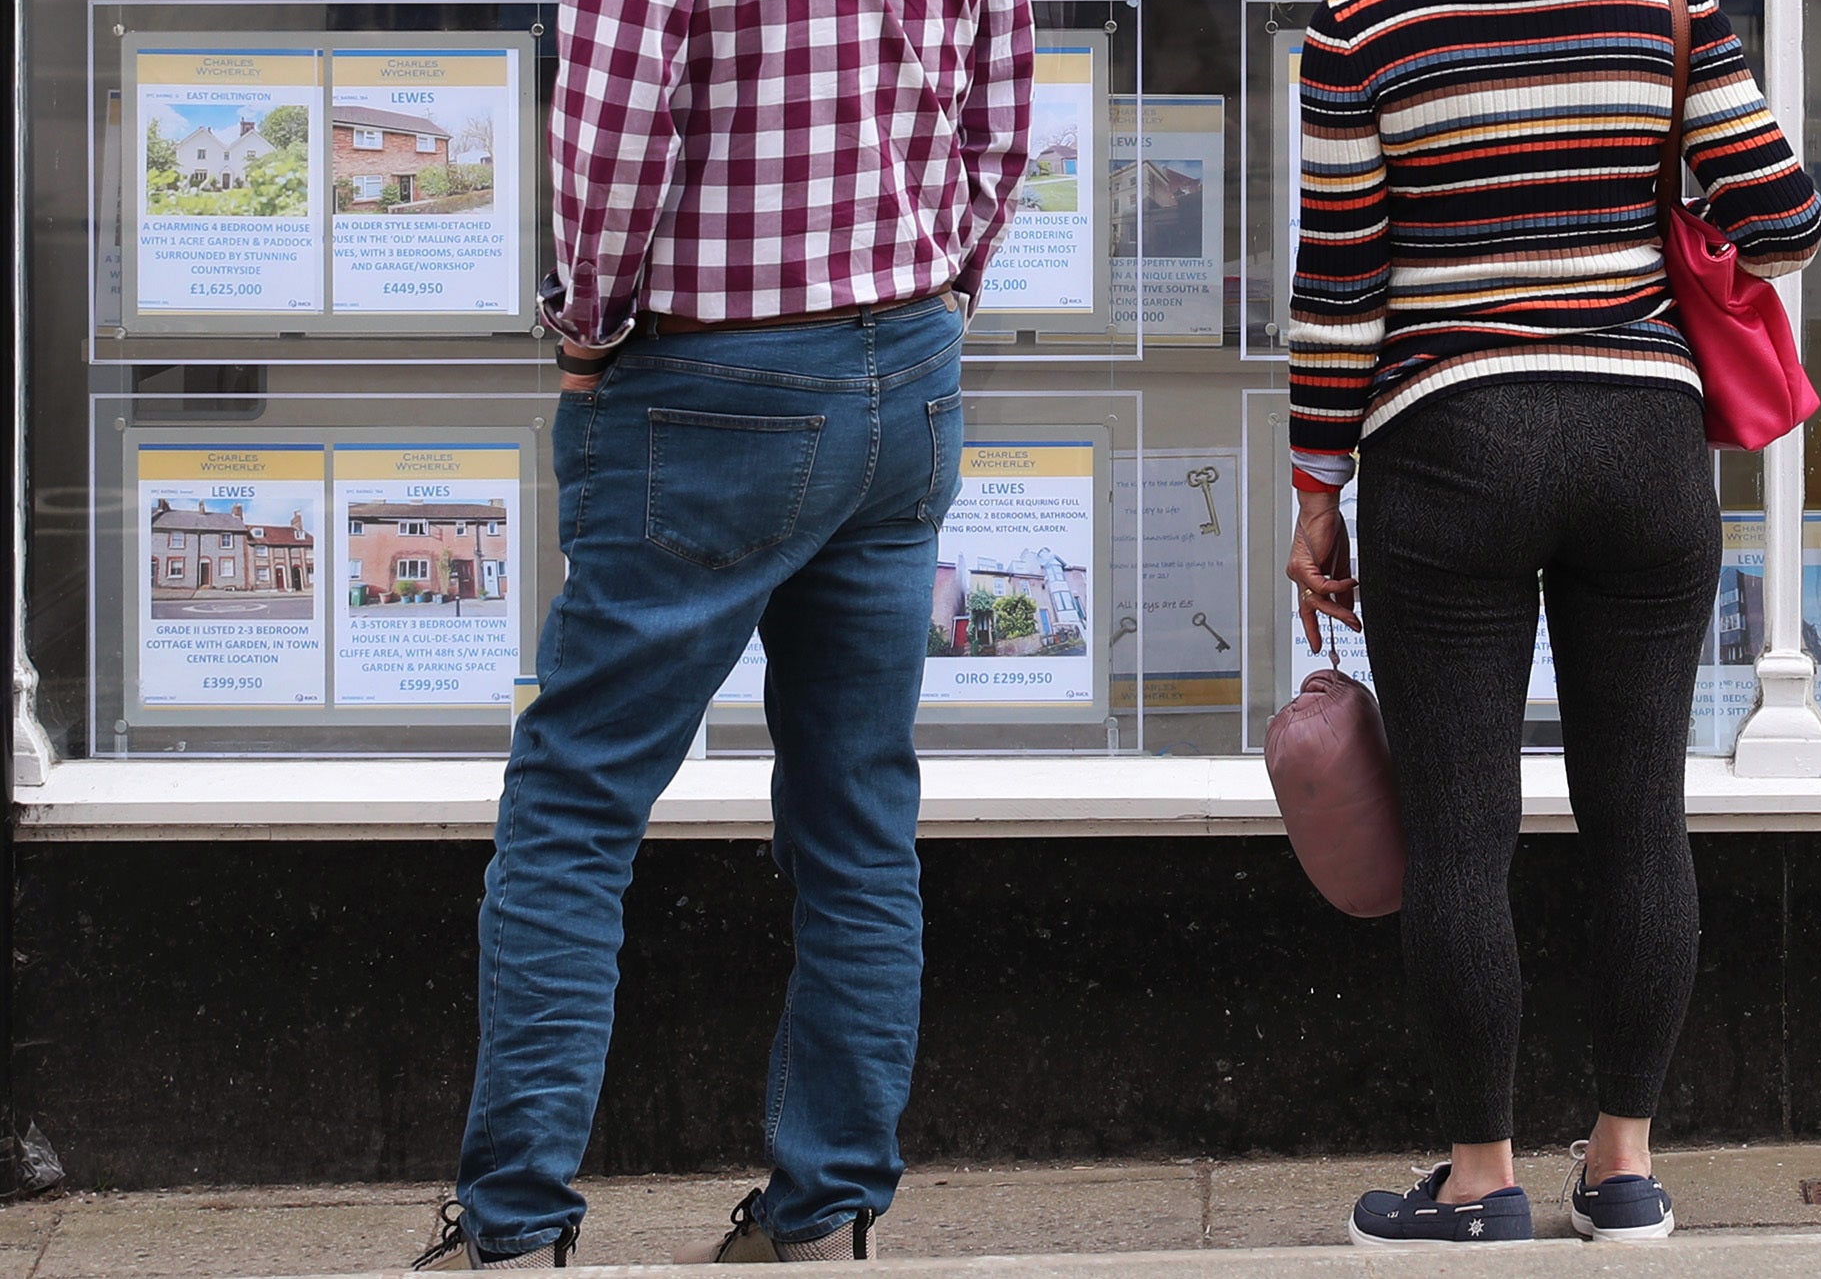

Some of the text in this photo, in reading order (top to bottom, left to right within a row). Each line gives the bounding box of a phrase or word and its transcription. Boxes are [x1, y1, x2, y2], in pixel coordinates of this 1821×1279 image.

[187, 92, 271, 101] EAST CHILTINGTON
[392, 92, 434, 103] LEWES
[1035, 216, 1087, 225] HOUSE ON
[1014, 231, 1073, 239] BORDERING
[1018, 259, 1068, 268] LOCATION
[191, 266, 261, 275] COUNTRYSIDE
[190, 283, 262, 296] £1,625,000
[384, 283, 443, 295] £449,950
[978, 450, 1028, 459] CHARLES
[971, 459, 1035, 468] WYCHERLEY
[212, 486, 255, 497] LEWES
[407, 486, 450, 497] LEWES
[982, 483, 1024, 494] LEWES
[187, 654, 278, 663] CENTRE LOCATION
[203, 677, 262, 690] £399,950
[955, 673, 1052, 685] OIRO £299,950
[400, 679, 459, 692] £599,950
